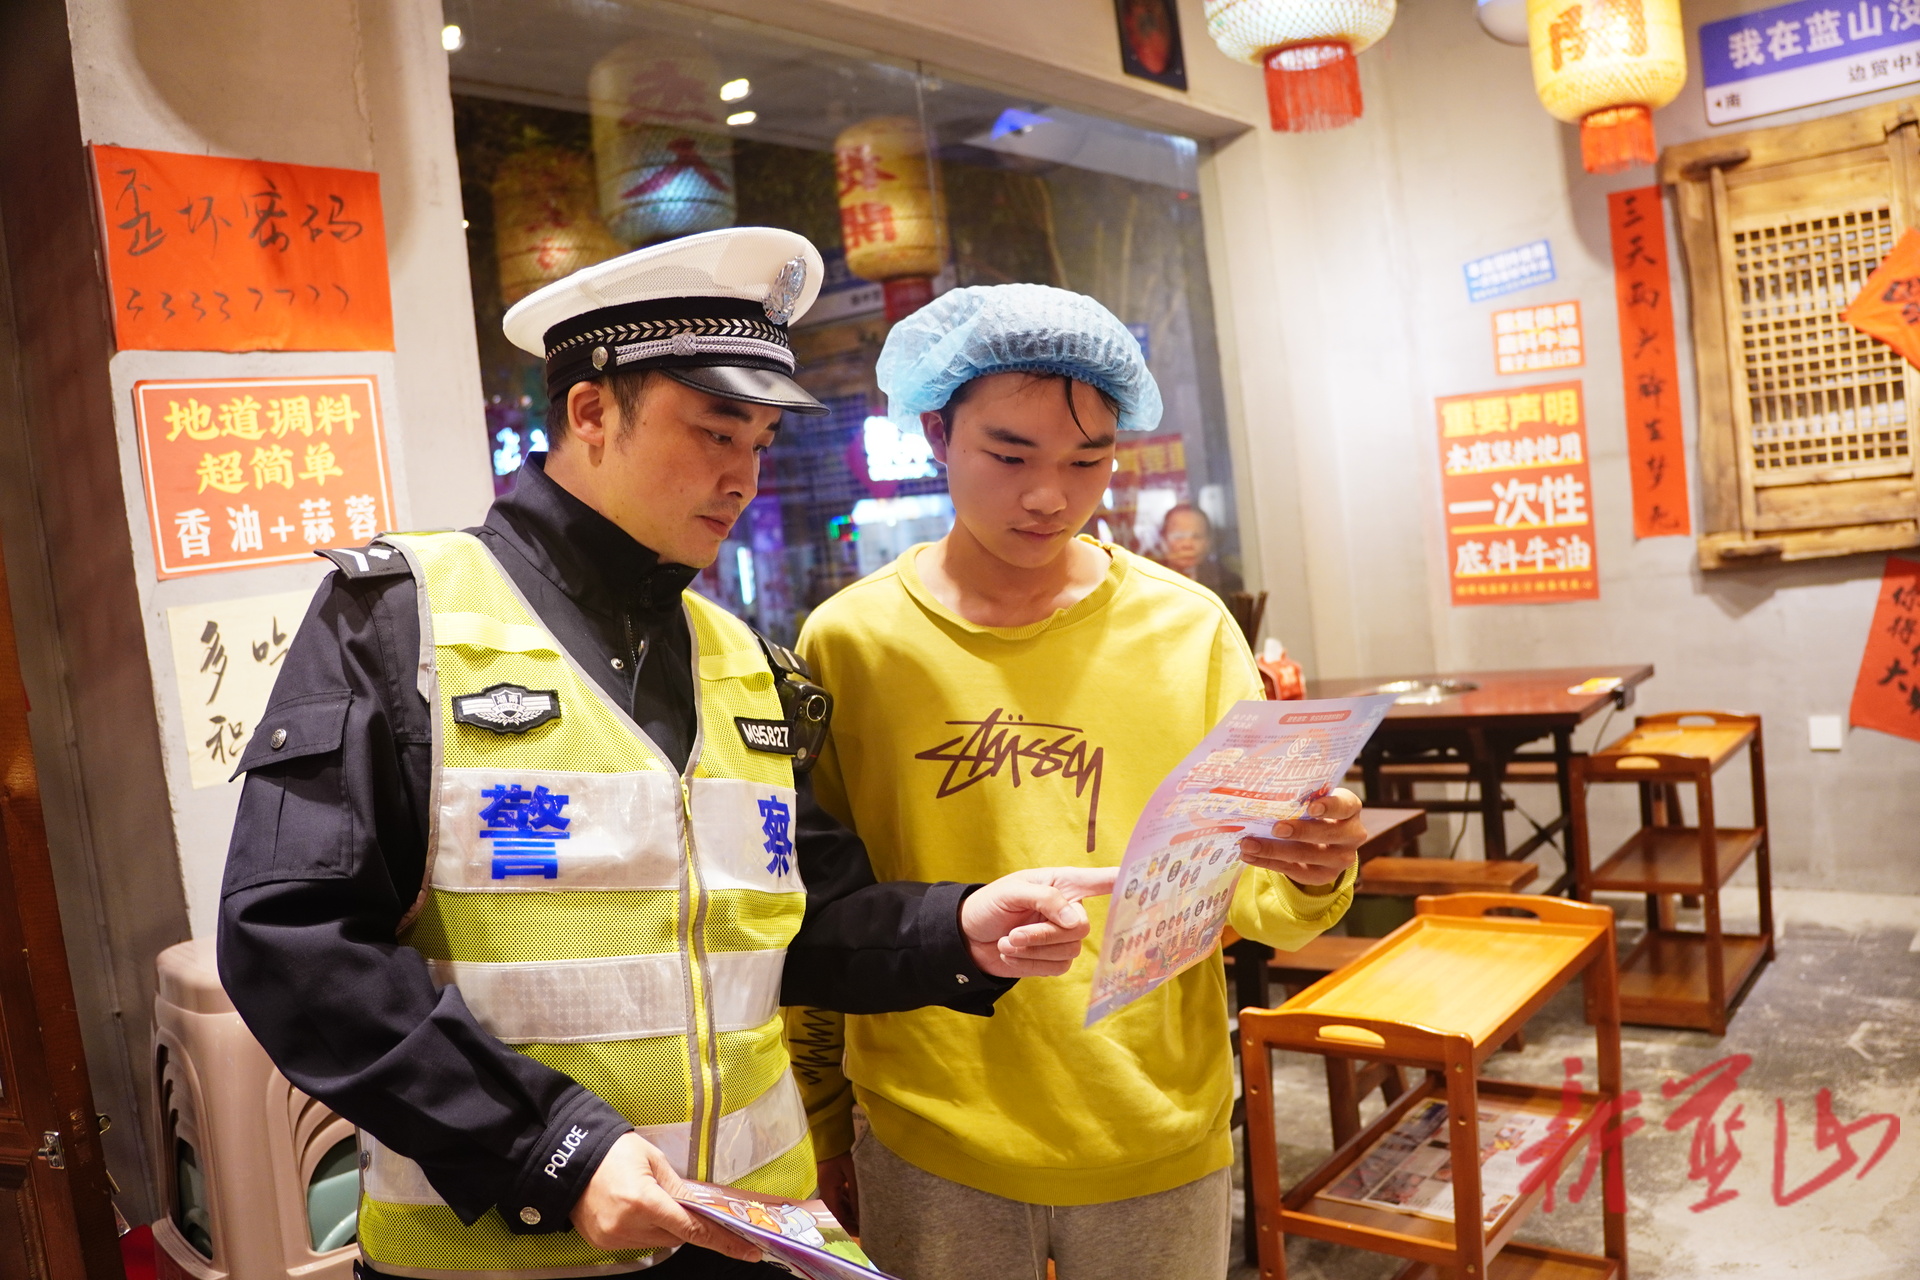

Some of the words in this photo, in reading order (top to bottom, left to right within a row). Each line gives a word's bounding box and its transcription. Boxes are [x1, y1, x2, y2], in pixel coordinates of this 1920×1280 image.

[1850, 52, 1920, 82] 边贸中
[163, 394, 361, 442] 地道调料
[1441, 389, 1579, 438] 重要声明
[196, 442, 343, 495] 超简单
[1446, 432, 1583, 473] 本店坚持使用
[1448, 473, 1588, 528] 一次性
[174, 494, 378, 559] 香油+蒜蓉
[1455, 534, 1592, 575] 底料牛油
[742, 723, 789, 748] M95827
[479, 784, 571, 880] 警
[544, 1125, 588, 1179] POLICE
